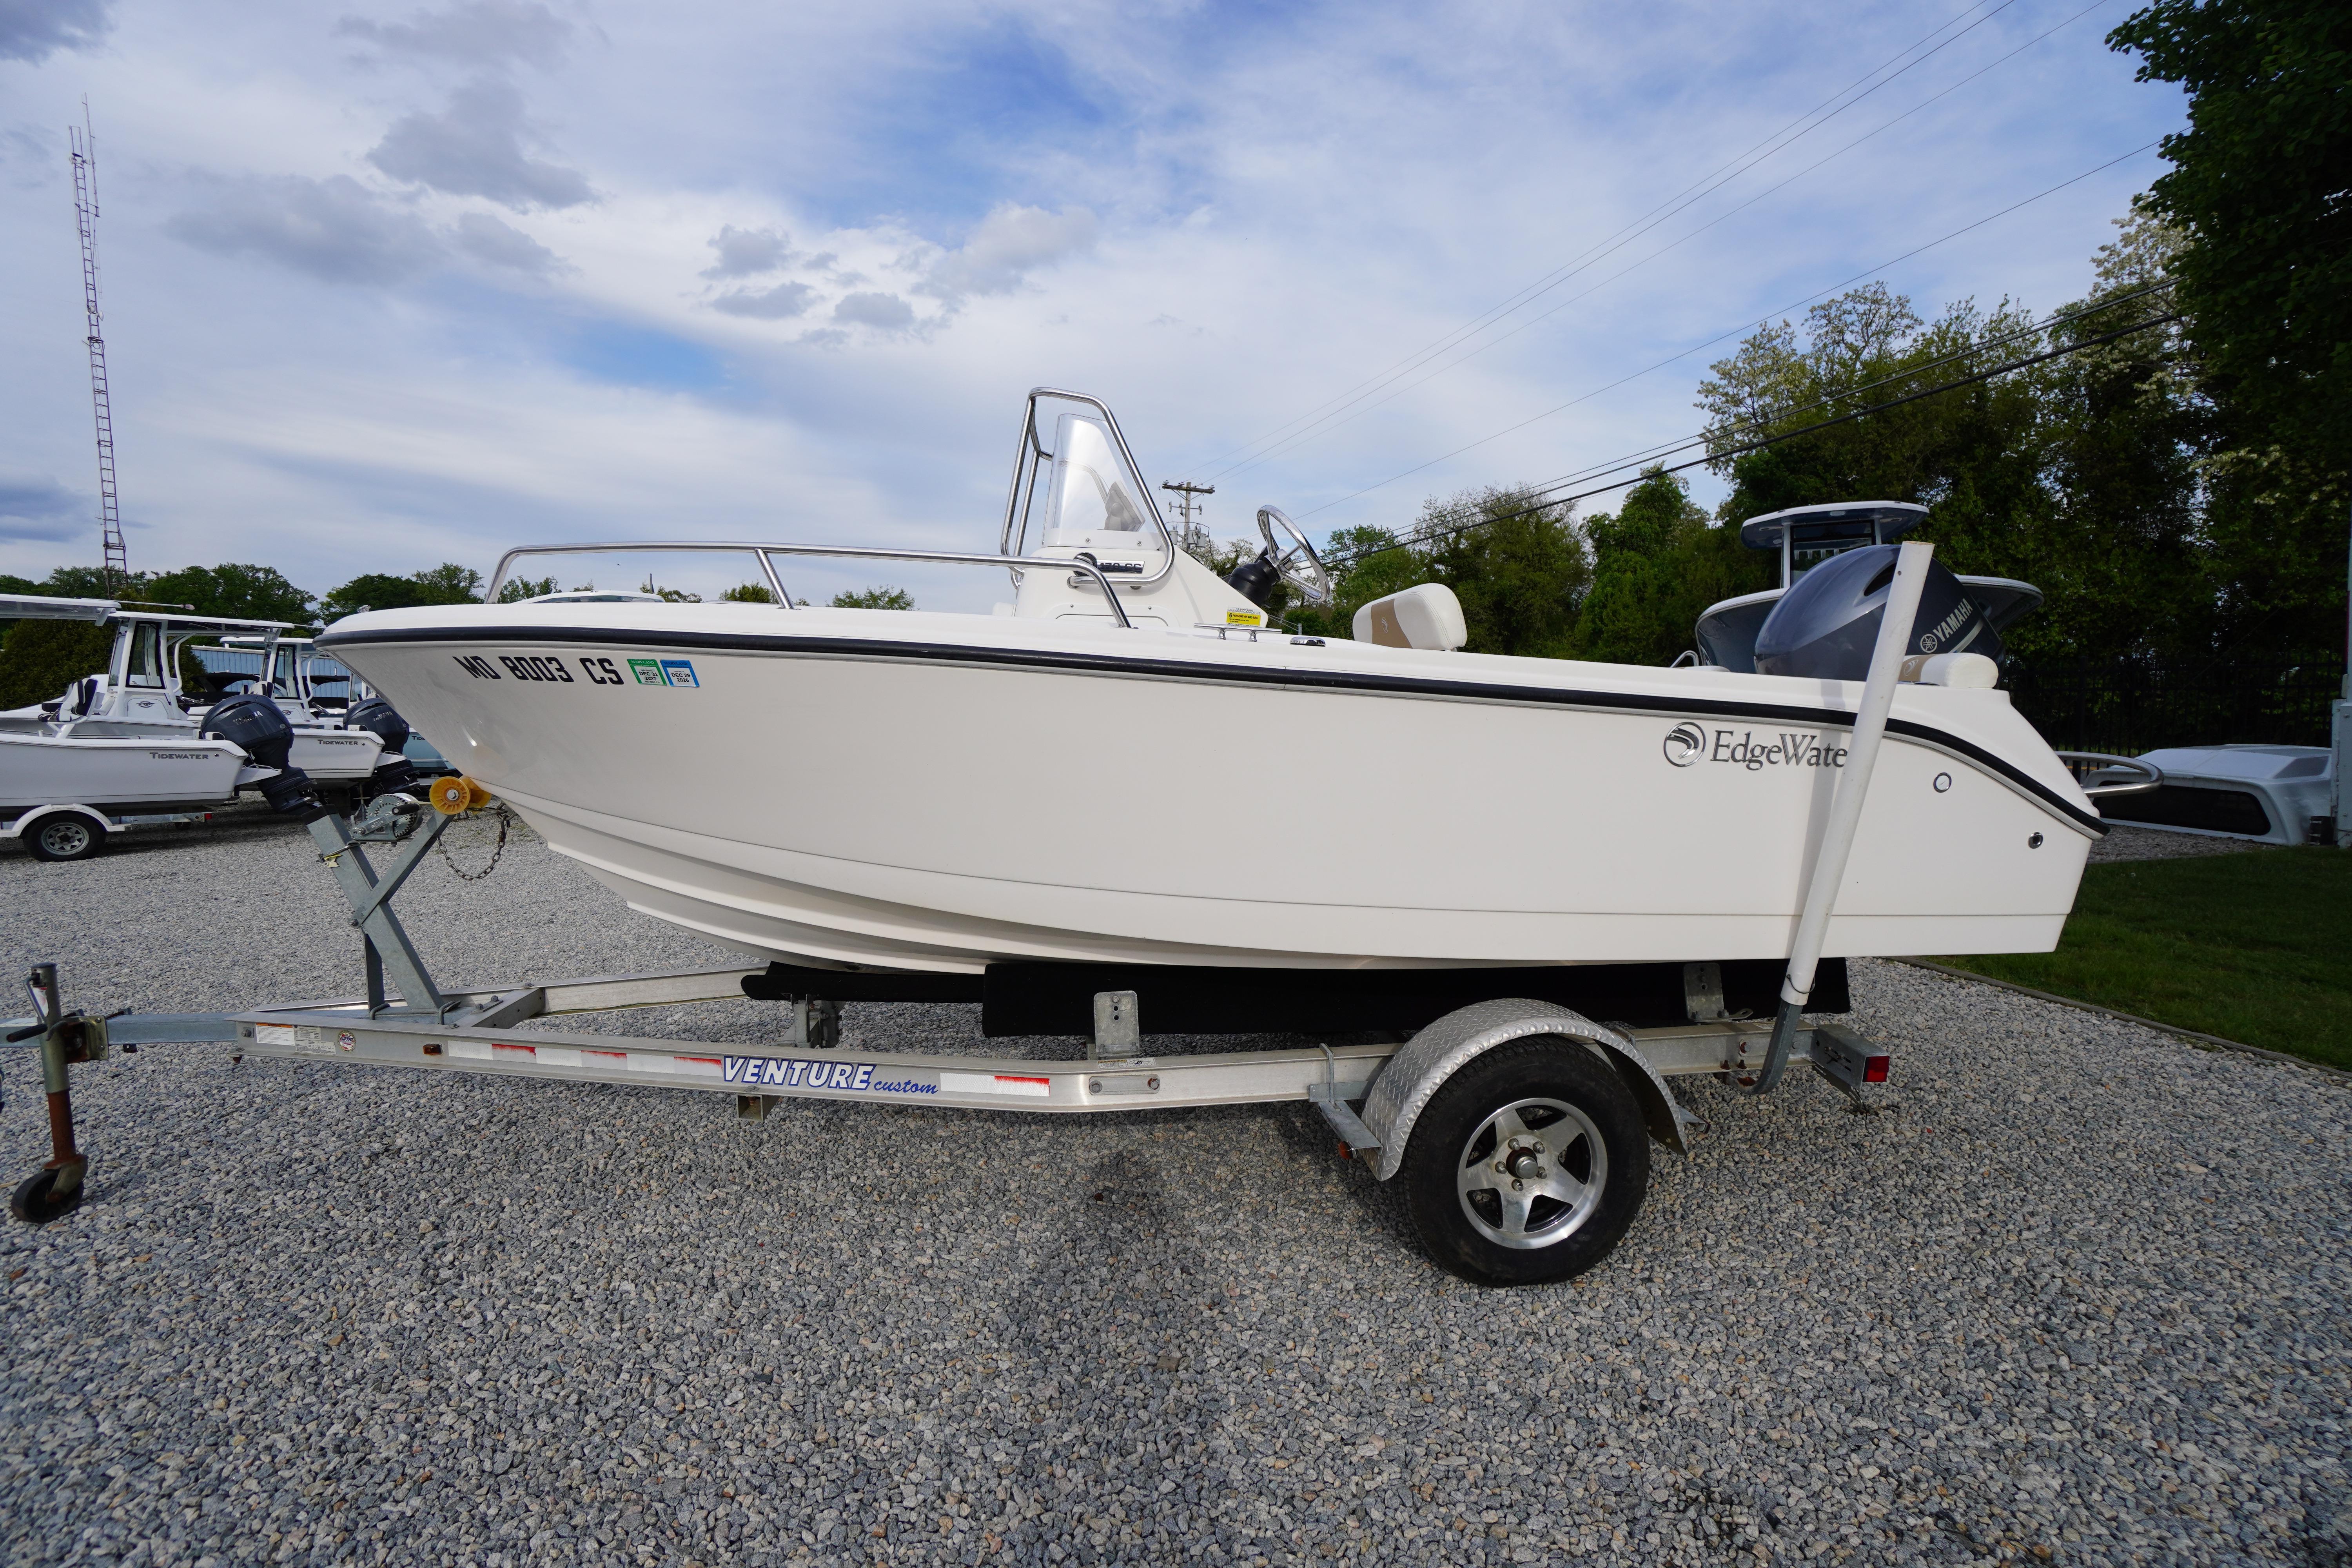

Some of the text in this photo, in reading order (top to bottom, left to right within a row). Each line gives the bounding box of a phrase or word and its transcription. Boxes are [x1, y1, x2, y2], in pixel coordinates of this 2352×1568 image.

[1933, 598, 1973, 642] YAMAHA
[452, 656, 624, 685] MD 8003 CS
[232, 711, 264, 725] YAMAHA
[1710, 730, 1848, 771] EdgeWate
[724, 1056, 877, 1091] VENTURE
[874, 1080, 938, 1094] custom
